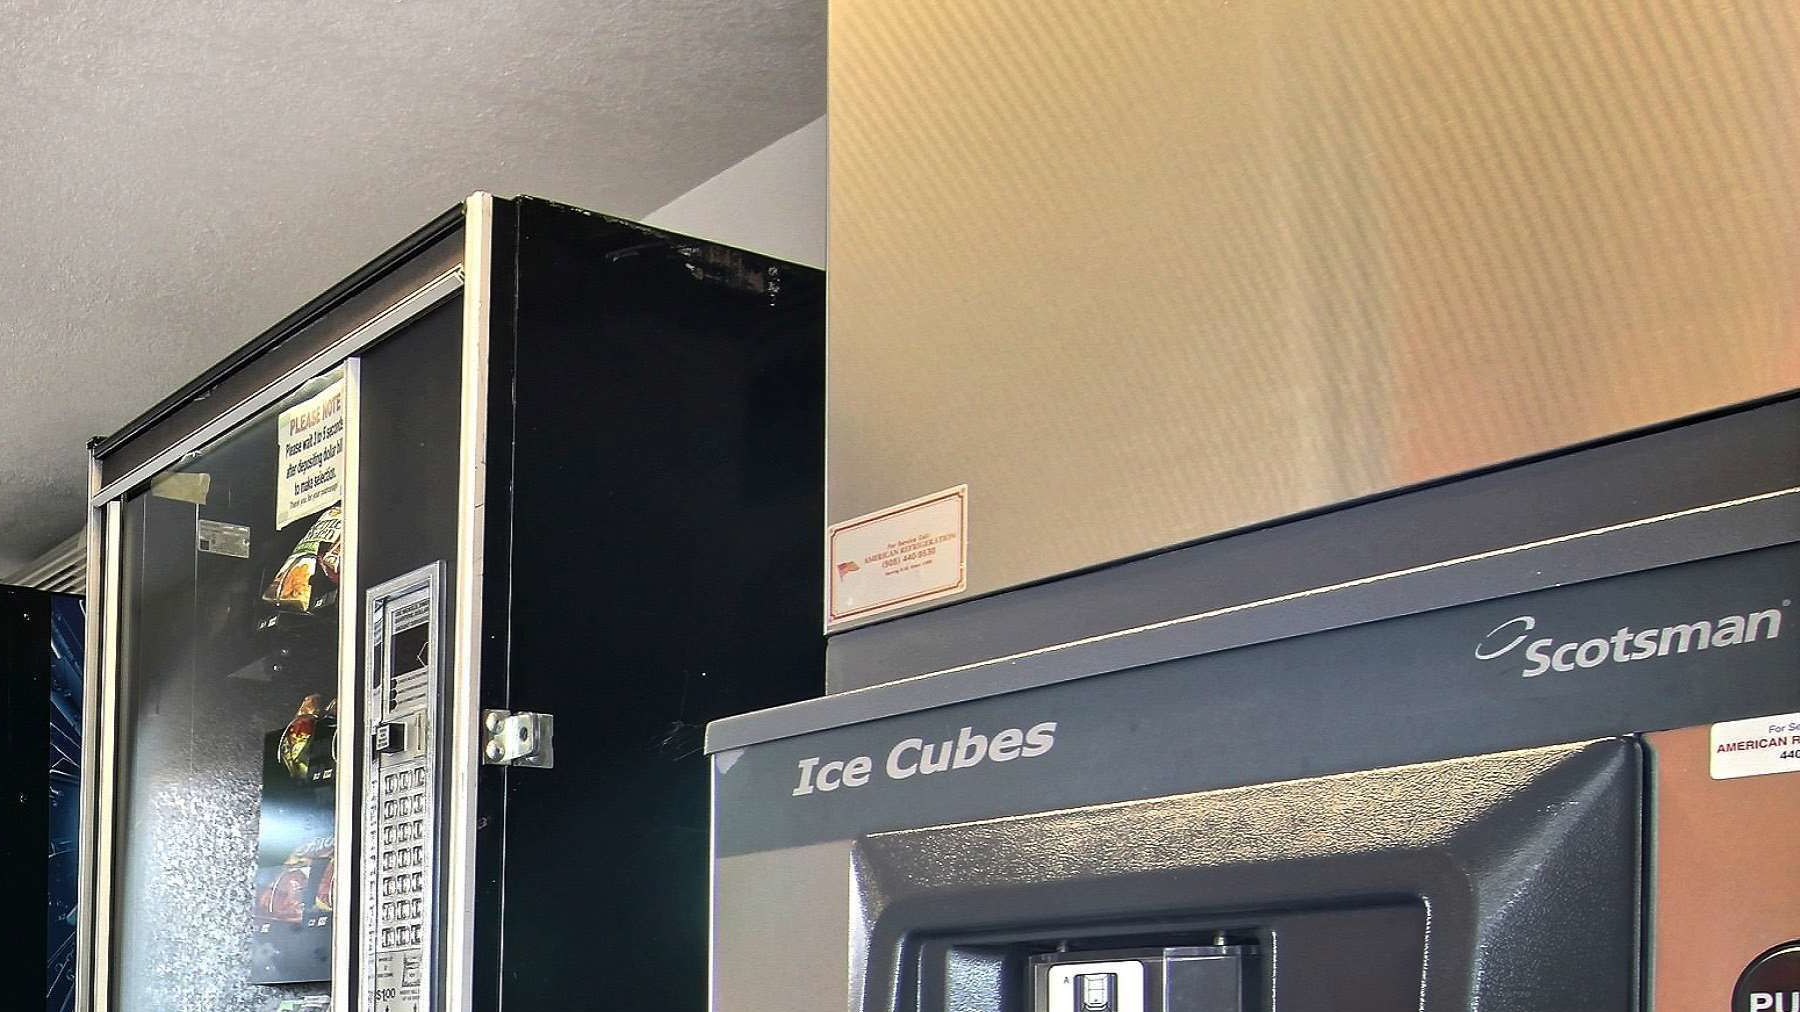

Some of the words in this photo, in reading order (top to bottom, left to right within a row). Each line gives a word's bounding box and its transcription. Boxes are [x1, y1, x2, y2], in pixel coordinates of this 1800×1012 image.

[289, 406, 321, 436] PLEASE
[322, 393, 342, 421] NOTE
[864, 549, 899, 563] AMERICAN
[1521, 607, 1783, 678] Scotsman
[1768, 725, 1786, 734] For
[791, 755, 873, 797] Ice
[885, 721, 1058, 780] Cubes
[1717, 736, 1788, 754] AMERICAN
